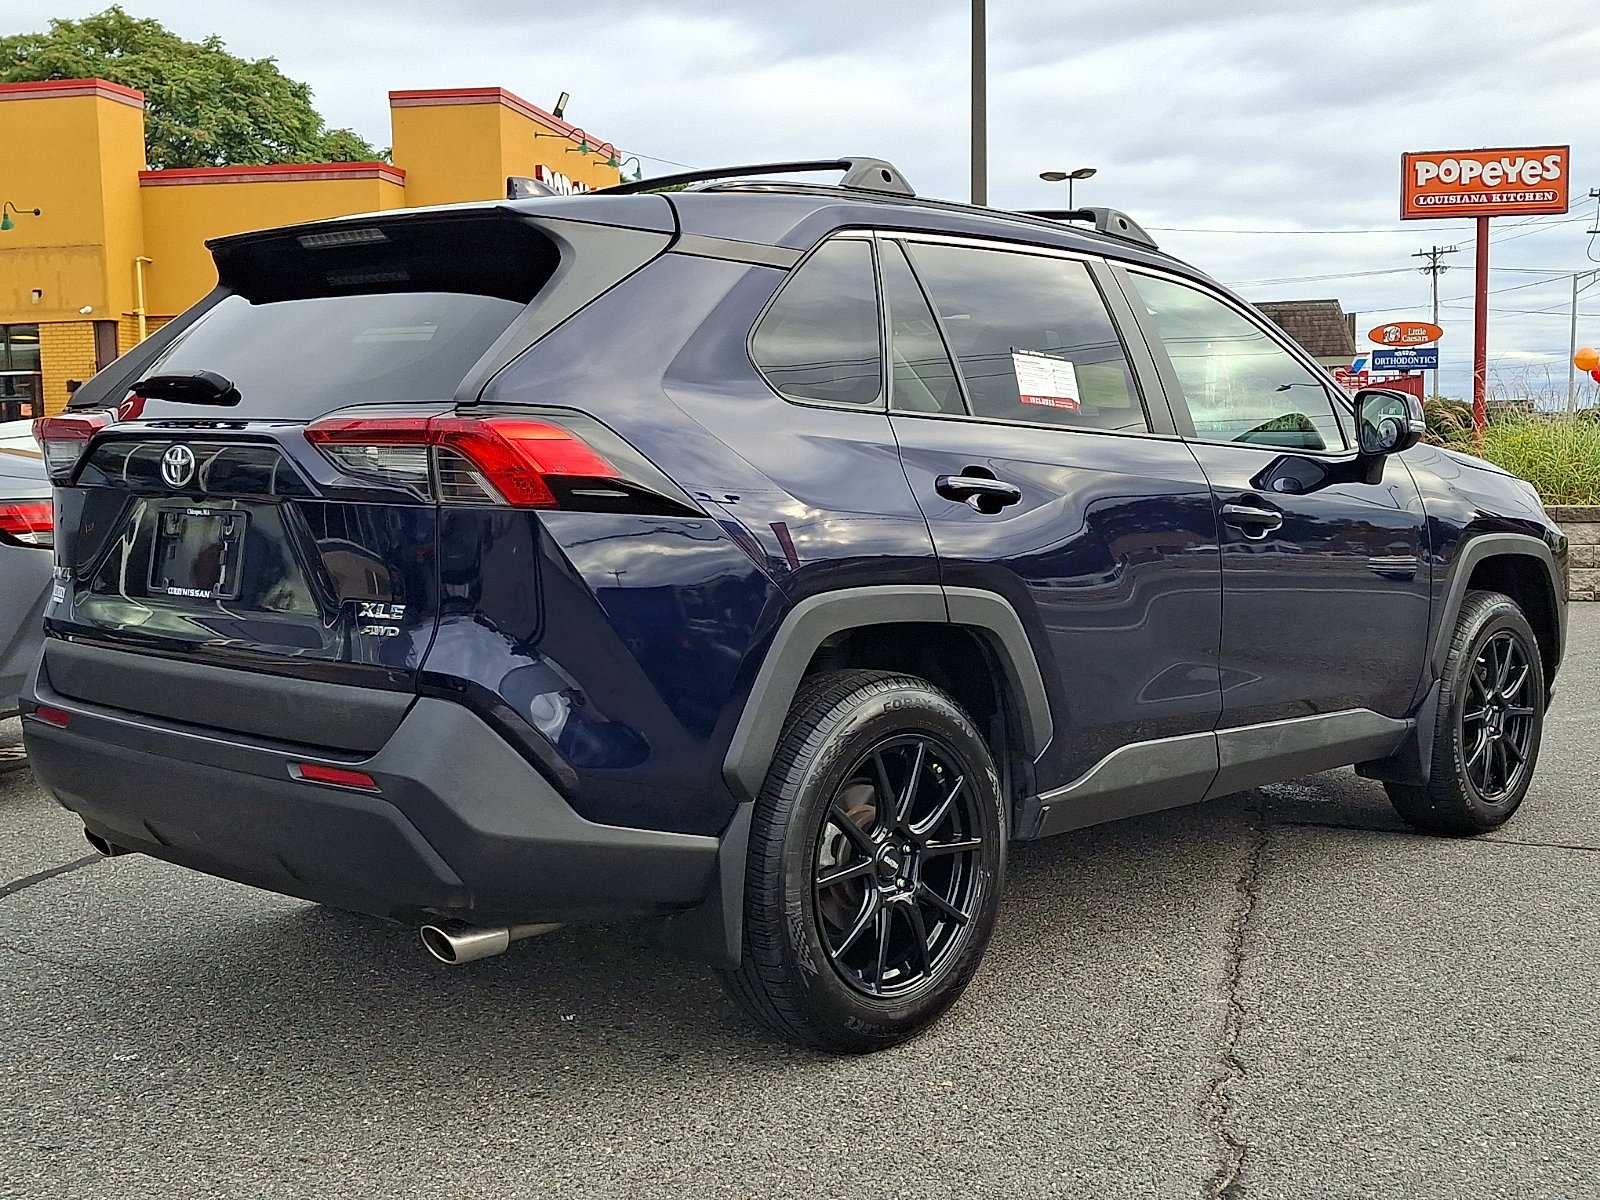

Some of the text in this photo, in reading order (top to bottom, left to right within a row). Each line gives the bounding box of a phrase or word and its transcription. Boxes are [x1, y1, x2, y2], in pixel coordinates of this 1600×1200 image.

[1419, 191, 1554, 205] LOUISIANA KITCHEN
[1407, 327, 1427, 336] Little
[1374, 355, 1437, 366] ORTHODONTICS
[183, 588, 211, 599] NISSAN
[358, 602, 406, 620] XLE
[360, 625, 400, 637] AWD
[882, 697, 932, 714] FORAY
